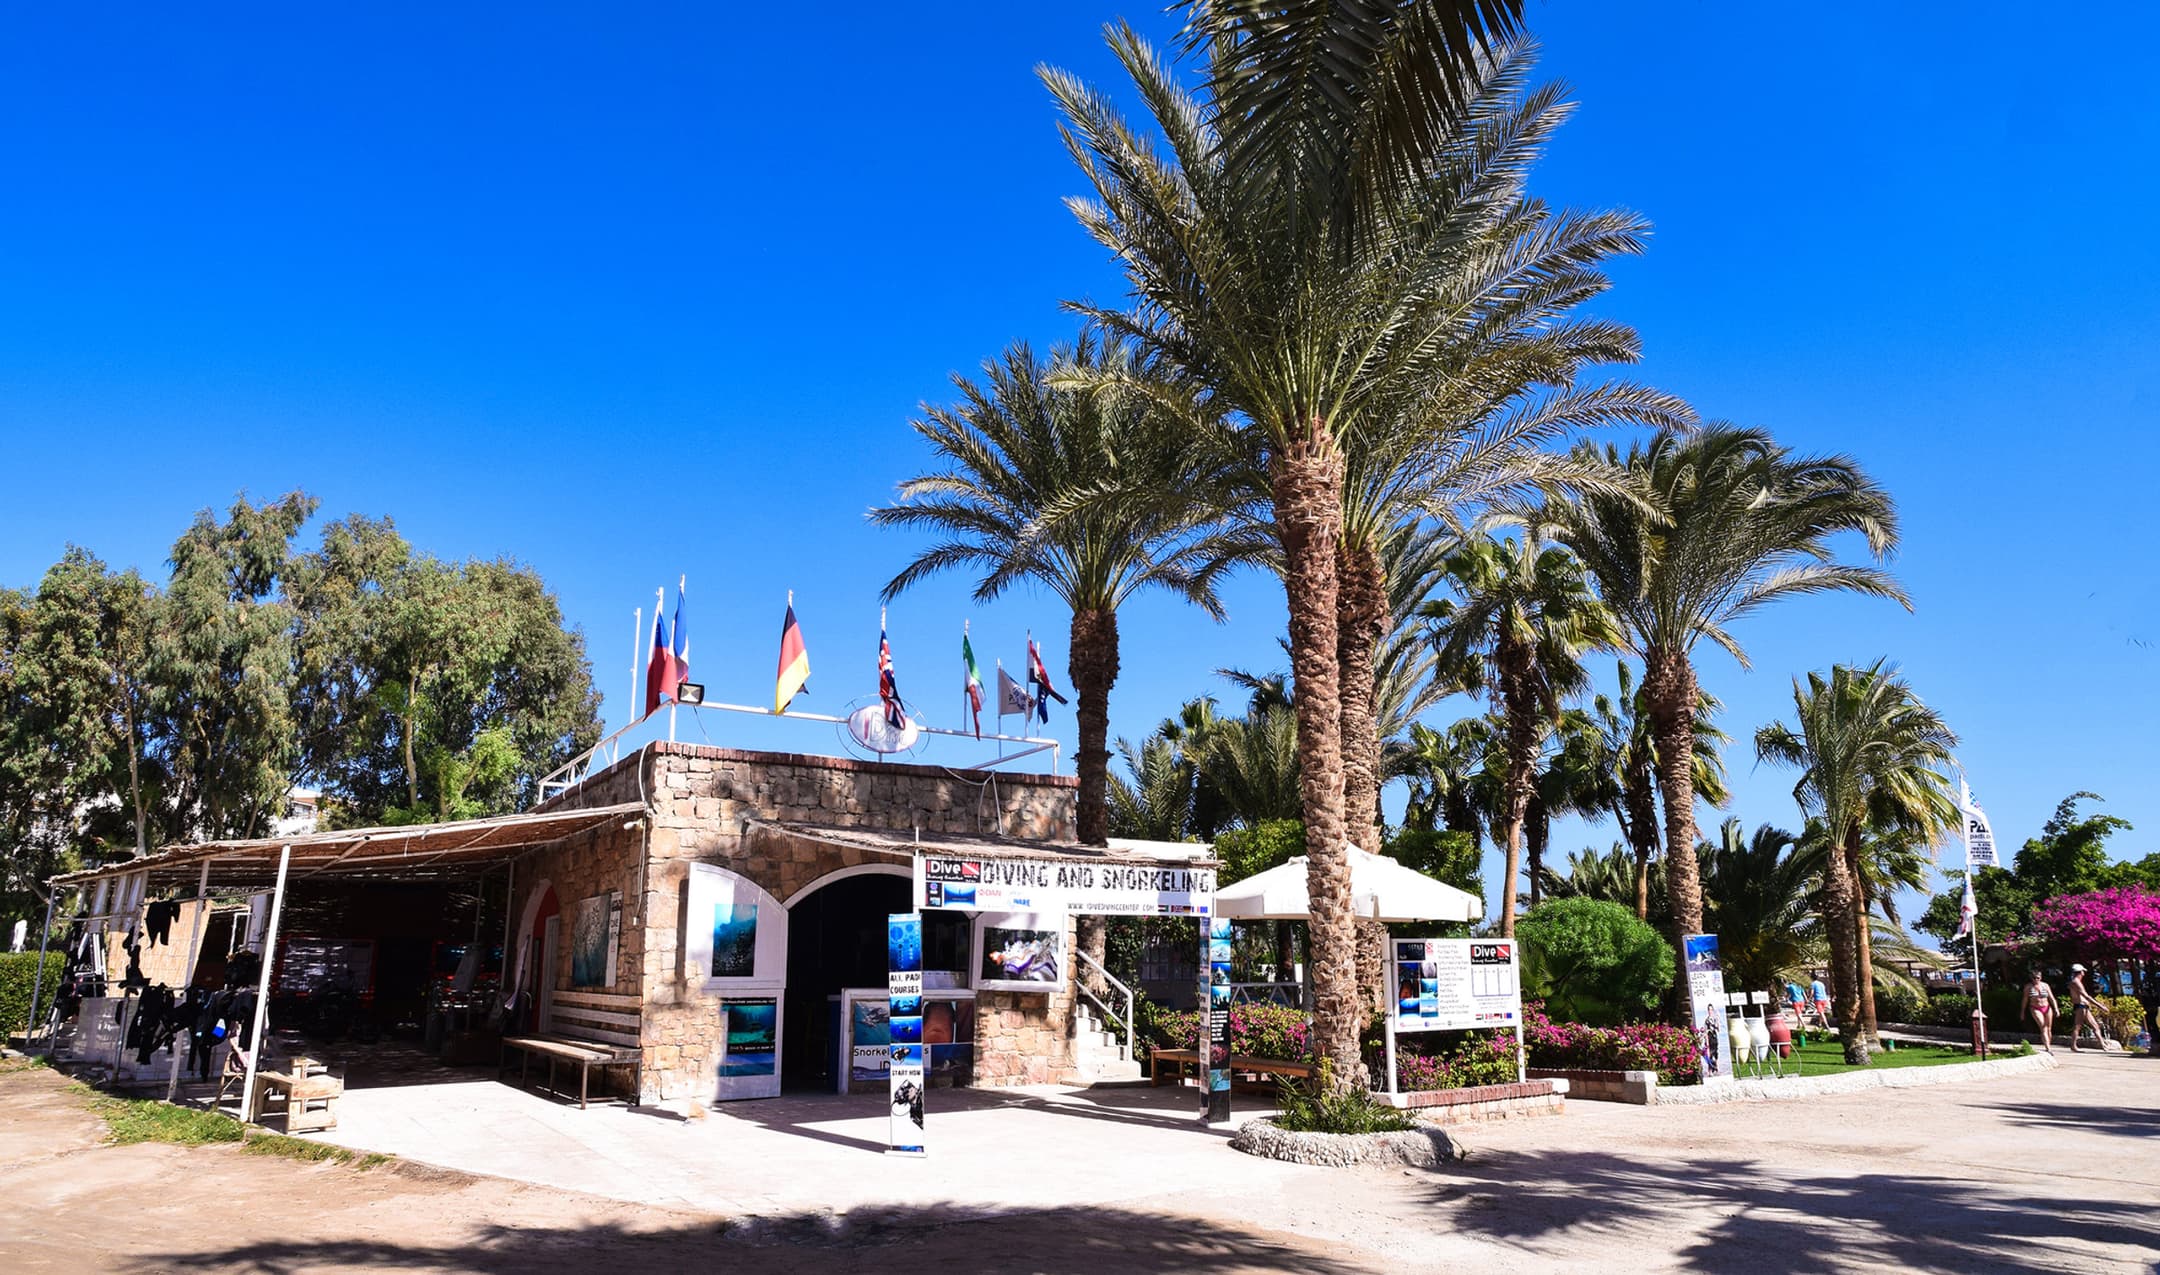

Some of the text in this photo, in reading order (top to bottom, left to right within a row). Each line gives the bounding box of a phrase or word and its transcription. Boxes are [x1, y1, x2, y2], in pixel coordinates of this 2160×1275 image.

[983, 861, 1209, 893] DIVING AND SNORKELING
[890, 973, 921, 982] ALL PADI
[890, 986, 919, 994] COURSES
